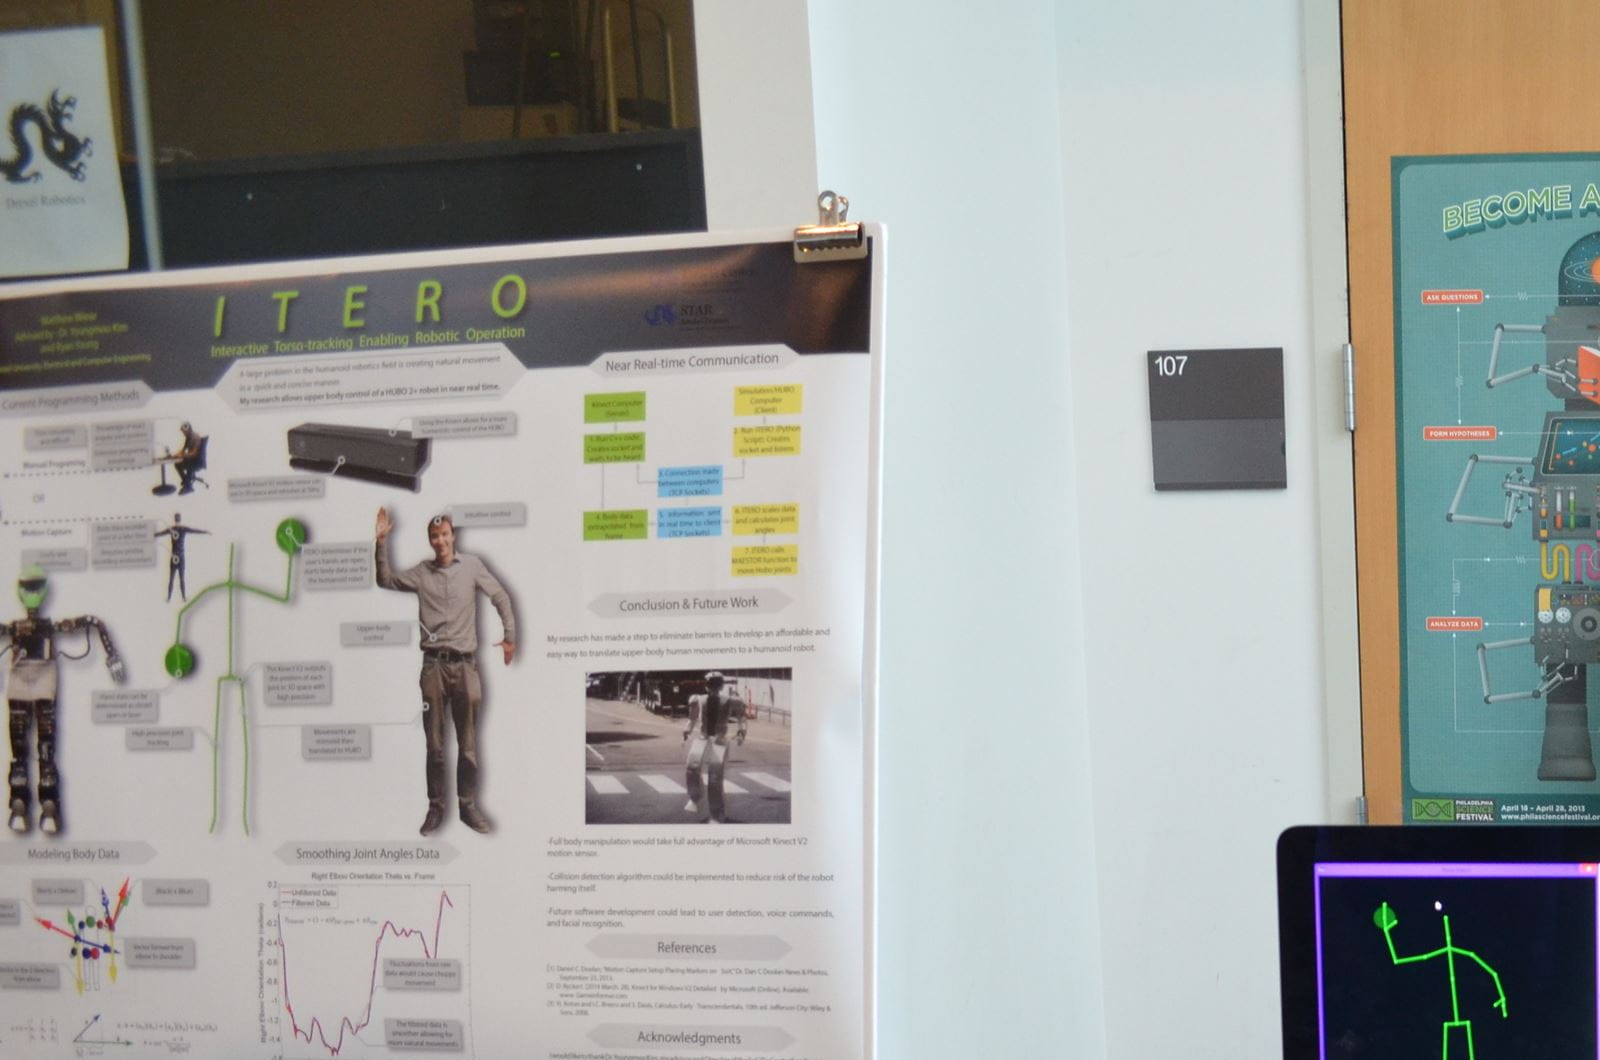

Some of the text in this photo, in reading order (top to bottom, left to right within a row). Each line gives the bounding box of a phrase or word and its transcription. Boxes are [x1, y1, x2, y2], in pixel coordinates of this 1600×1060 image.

[1442, 184, 1571, 234] BECOME
[211, 326, 525, 358] Interactive Torso-tracking Enabling Robotic Operation
[606, 353, 779, 372] Near Real-time Communication
[1155, 356, 1188, 376] 107
[619, 596, 759, 612] Conclusion & Future Work
[1456, 805, 1494, 814] SCIENCE
[1501, 804, 1519, 812] April
[1456, 813, 1494, 821] FESTIVAL
[28, 849, 120, 862] Modeling Body Data
[296, 848, 440, 862] Smoothing Joint Angles Data
[657, 941, 717, 954] References
[637, 1031, 741, 1046] Acknowledgments
